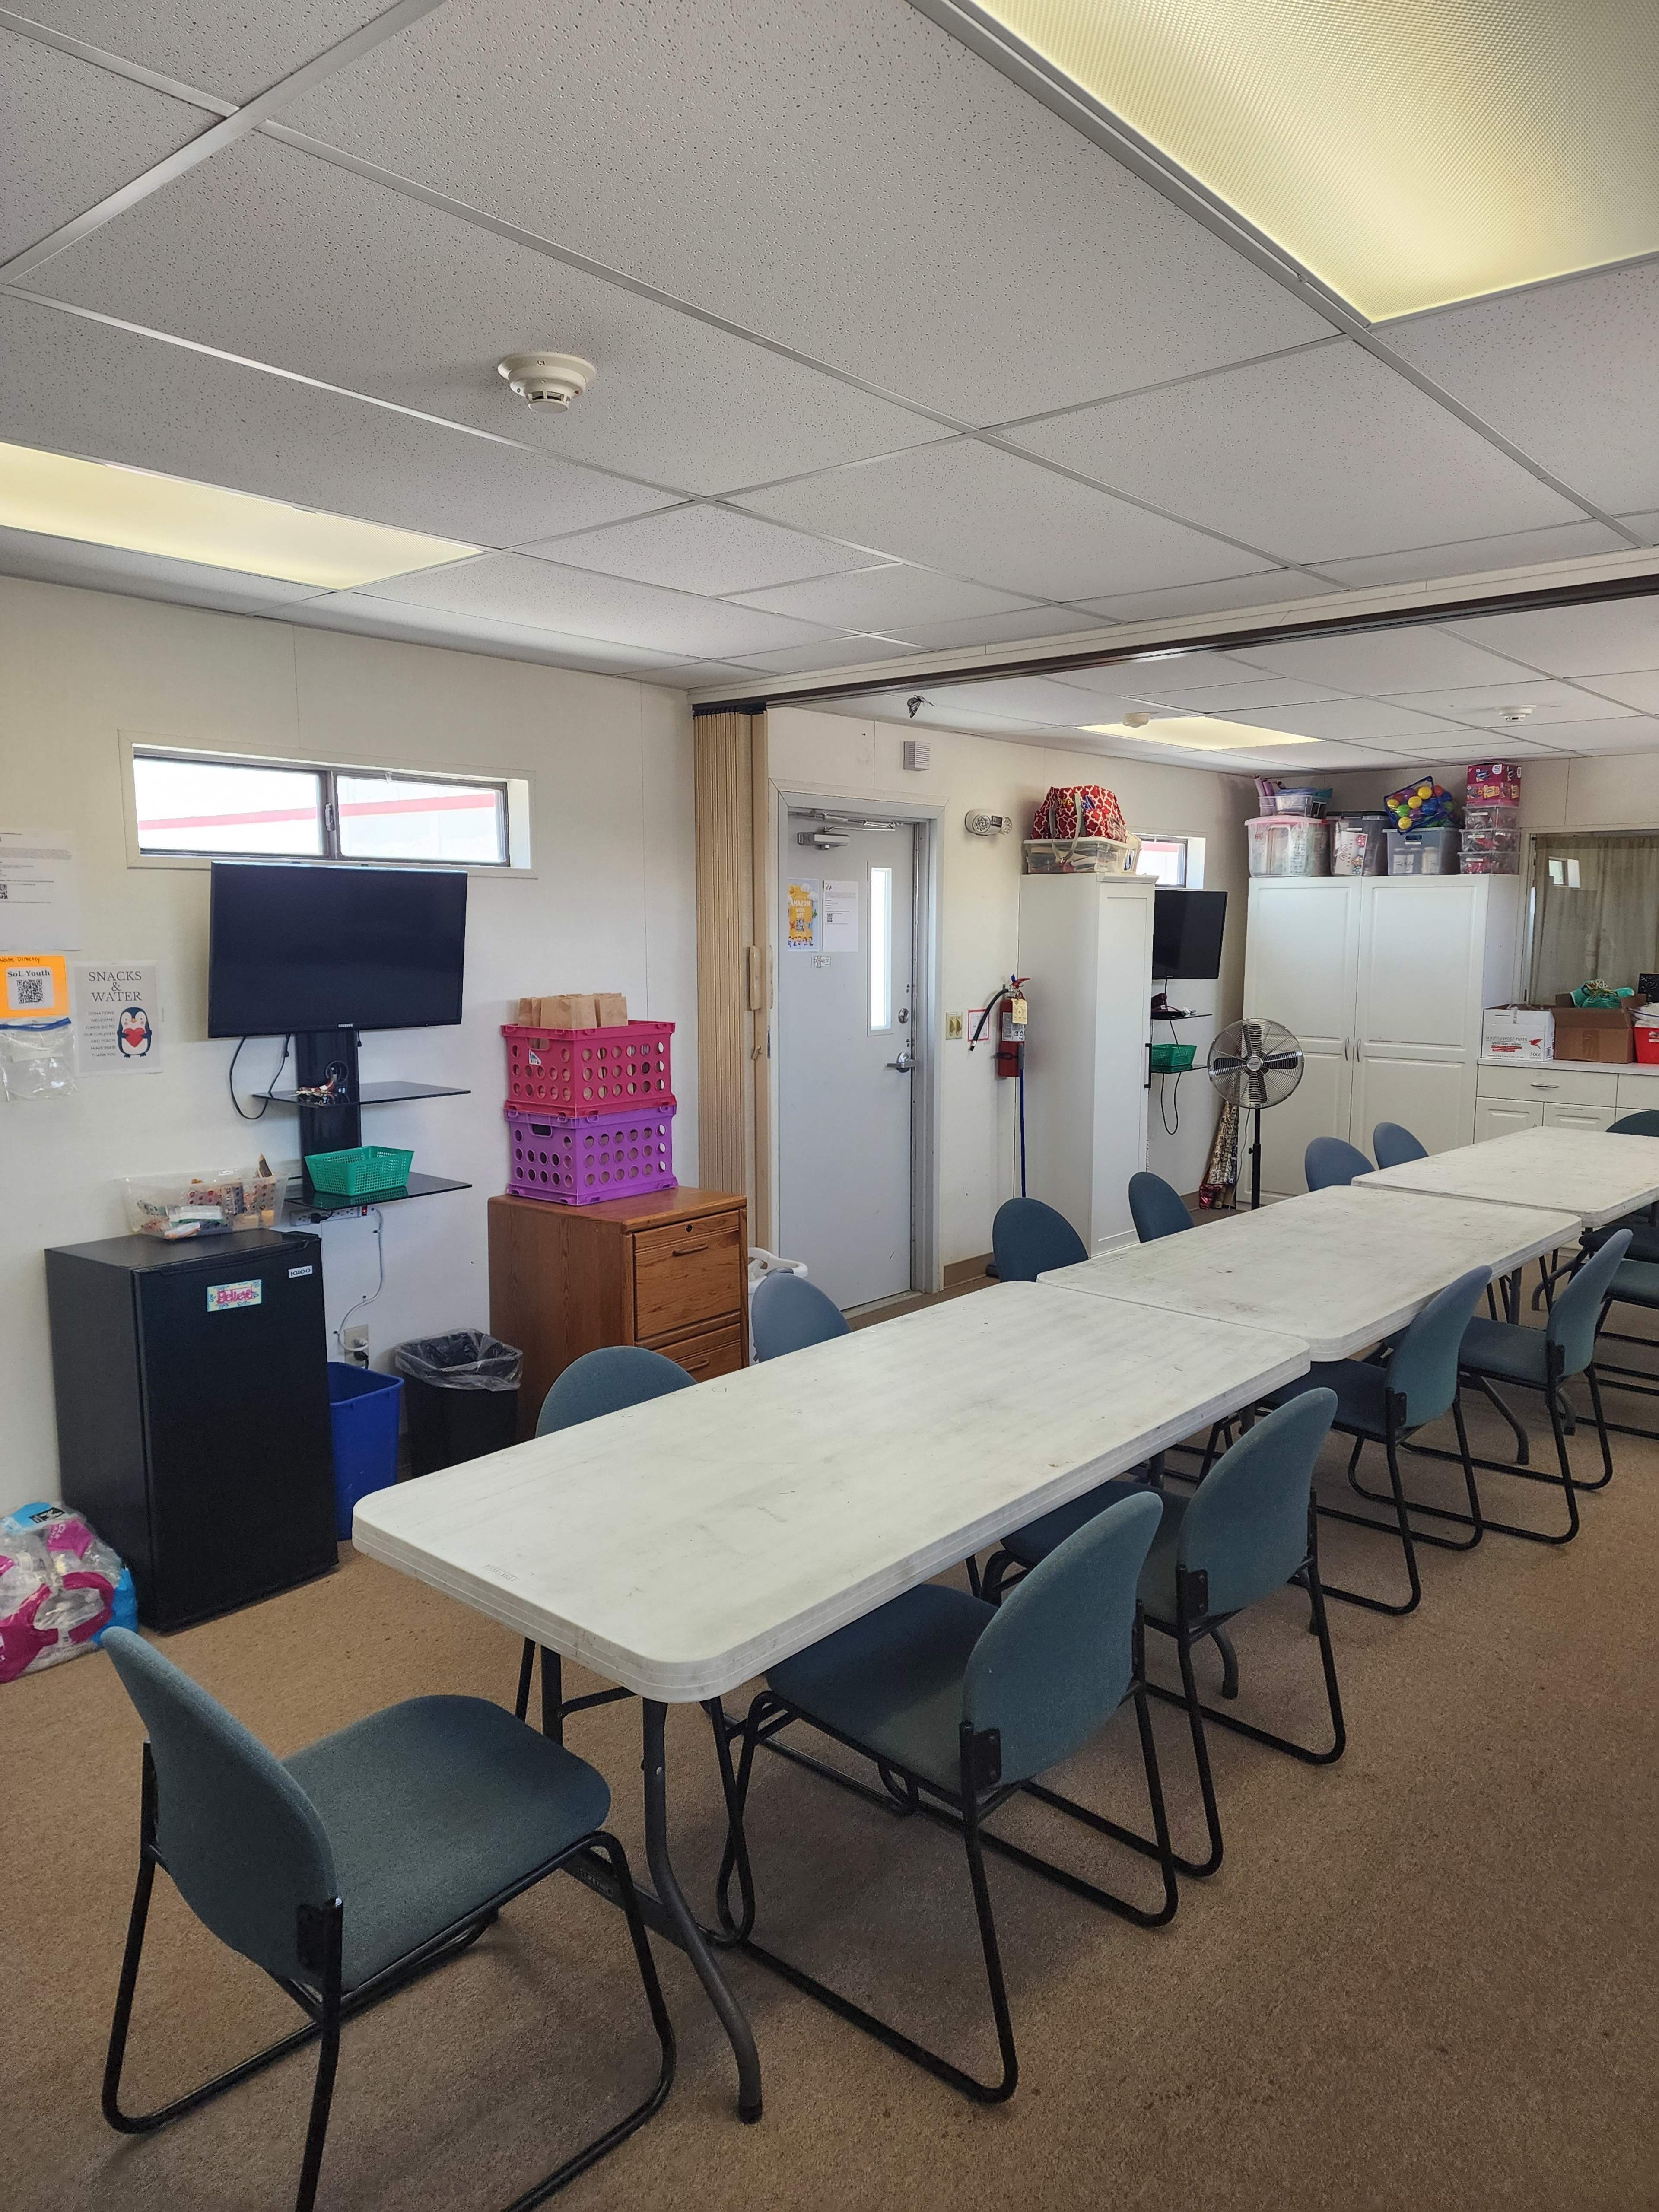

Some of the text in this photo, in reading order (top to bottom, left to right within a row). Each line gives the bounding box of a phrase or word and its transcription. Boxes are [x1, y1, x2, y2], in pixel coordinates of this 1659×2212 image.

[88, 971, 142, 982] SNACKS
[111, 982, 121, 991] &
[91, 992, 142, 1002] WATER
[290, 1268, 311, 1276] IGLOO
